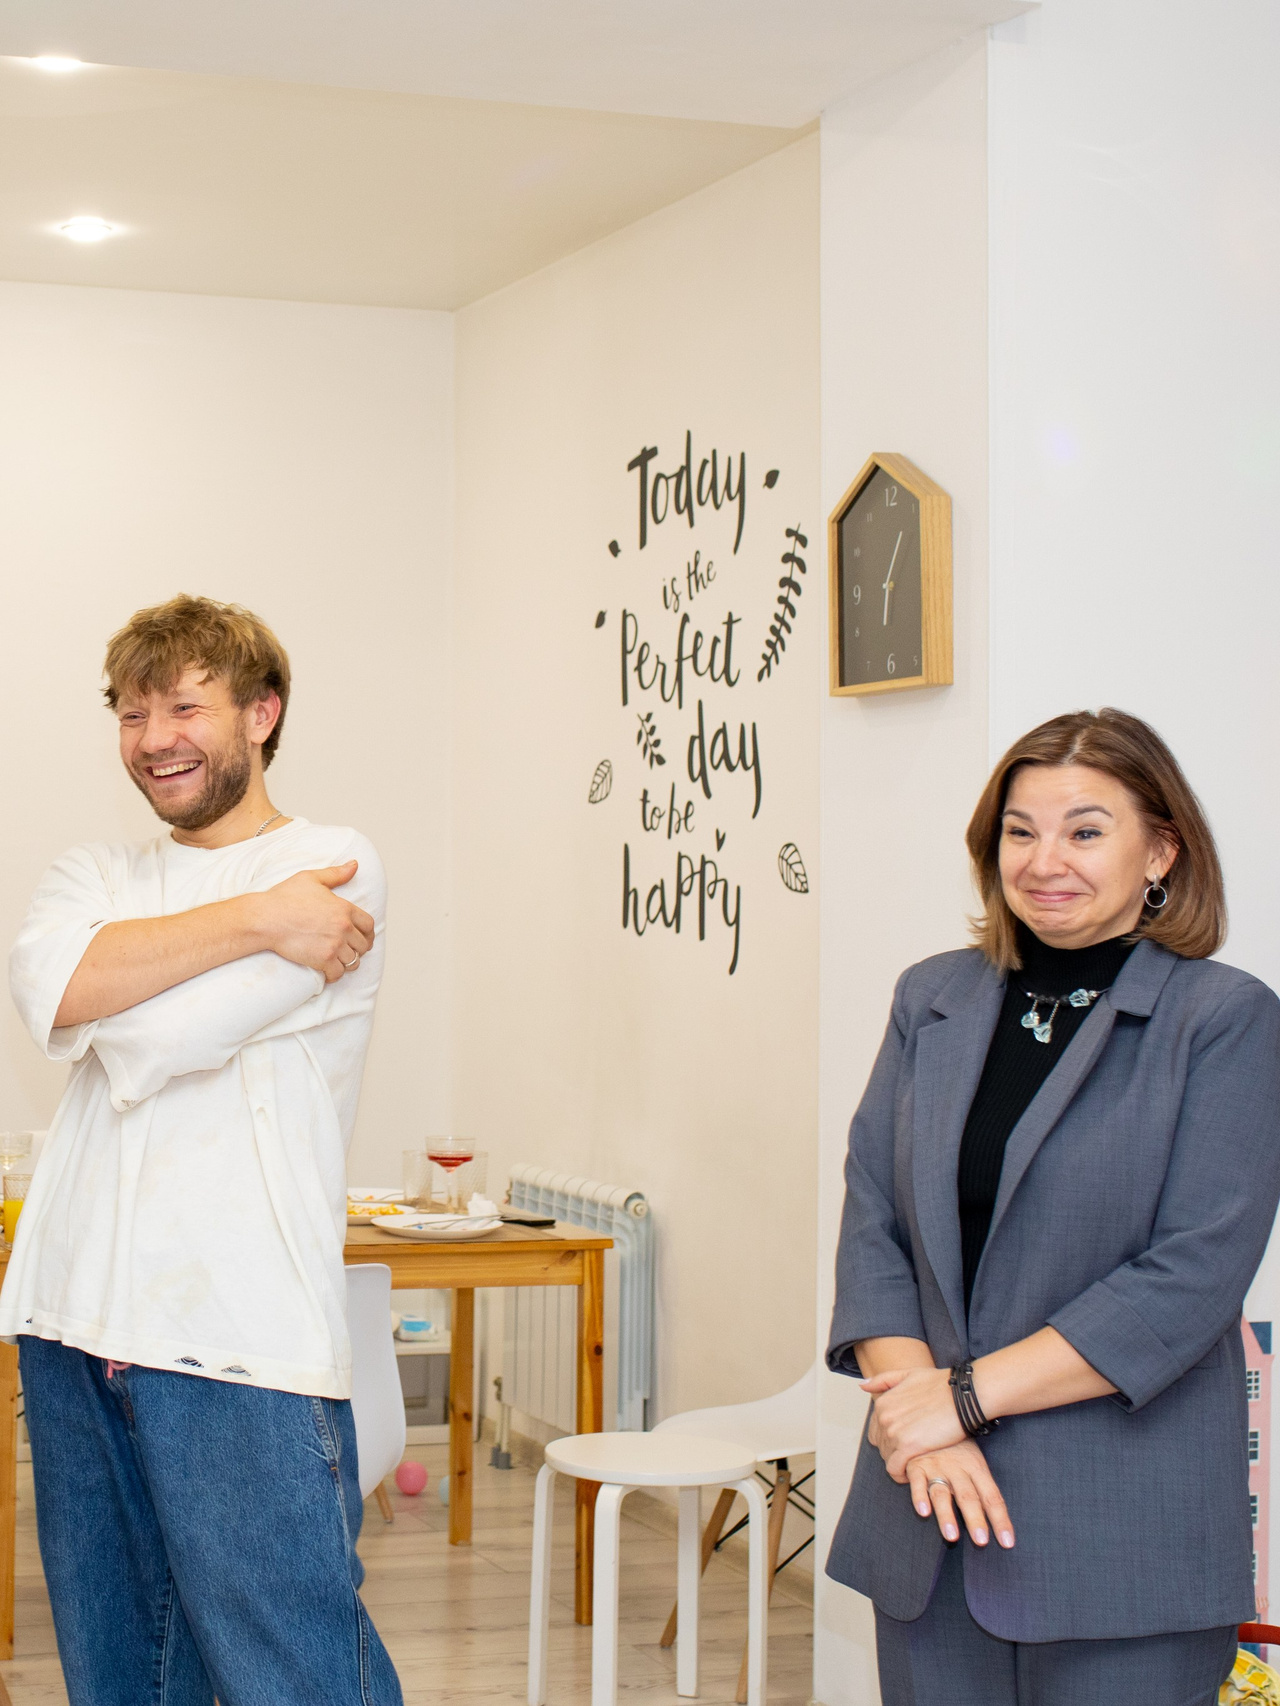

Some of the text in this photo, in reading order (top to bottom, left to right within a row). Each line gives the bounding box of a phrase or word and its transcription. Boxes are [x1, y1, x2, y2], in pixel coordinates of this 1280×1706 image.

[627, 429, 746, 556] Today
[884, 485, 898, 508] 12
[662, 550, 718, 614] is the
[853, 584, 862, 606] 9
[620, 608, 743, 711] Perfect
[886, 653, 896, 675] 6
[686, 699, 763, 820] day
[639, 781, 696, 840] to be
[622, 842, 742, 976] happy
